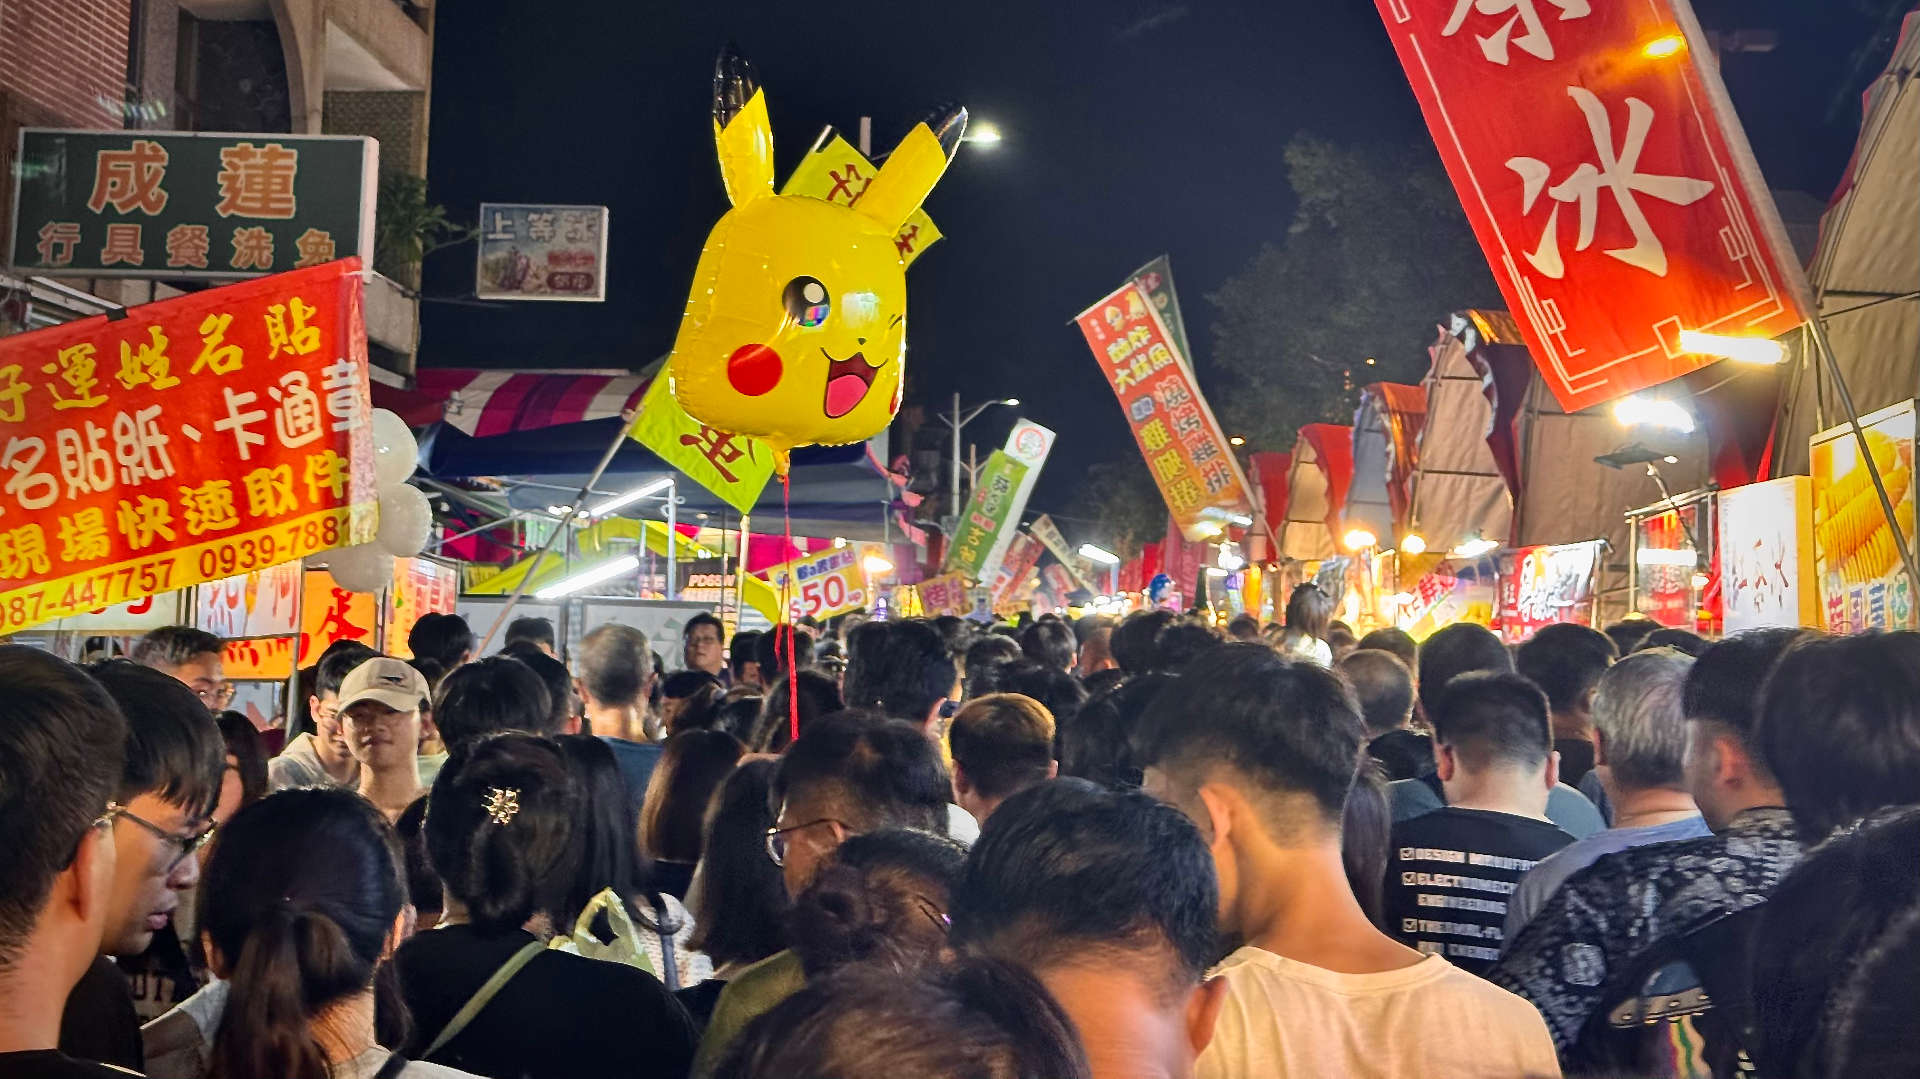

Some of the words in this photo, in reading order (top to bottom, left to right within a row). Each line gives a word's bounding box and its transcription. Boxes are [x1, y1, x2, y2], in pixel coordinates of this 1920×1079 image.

[0, 358, 366, 516] 名貼紙、卡通章
